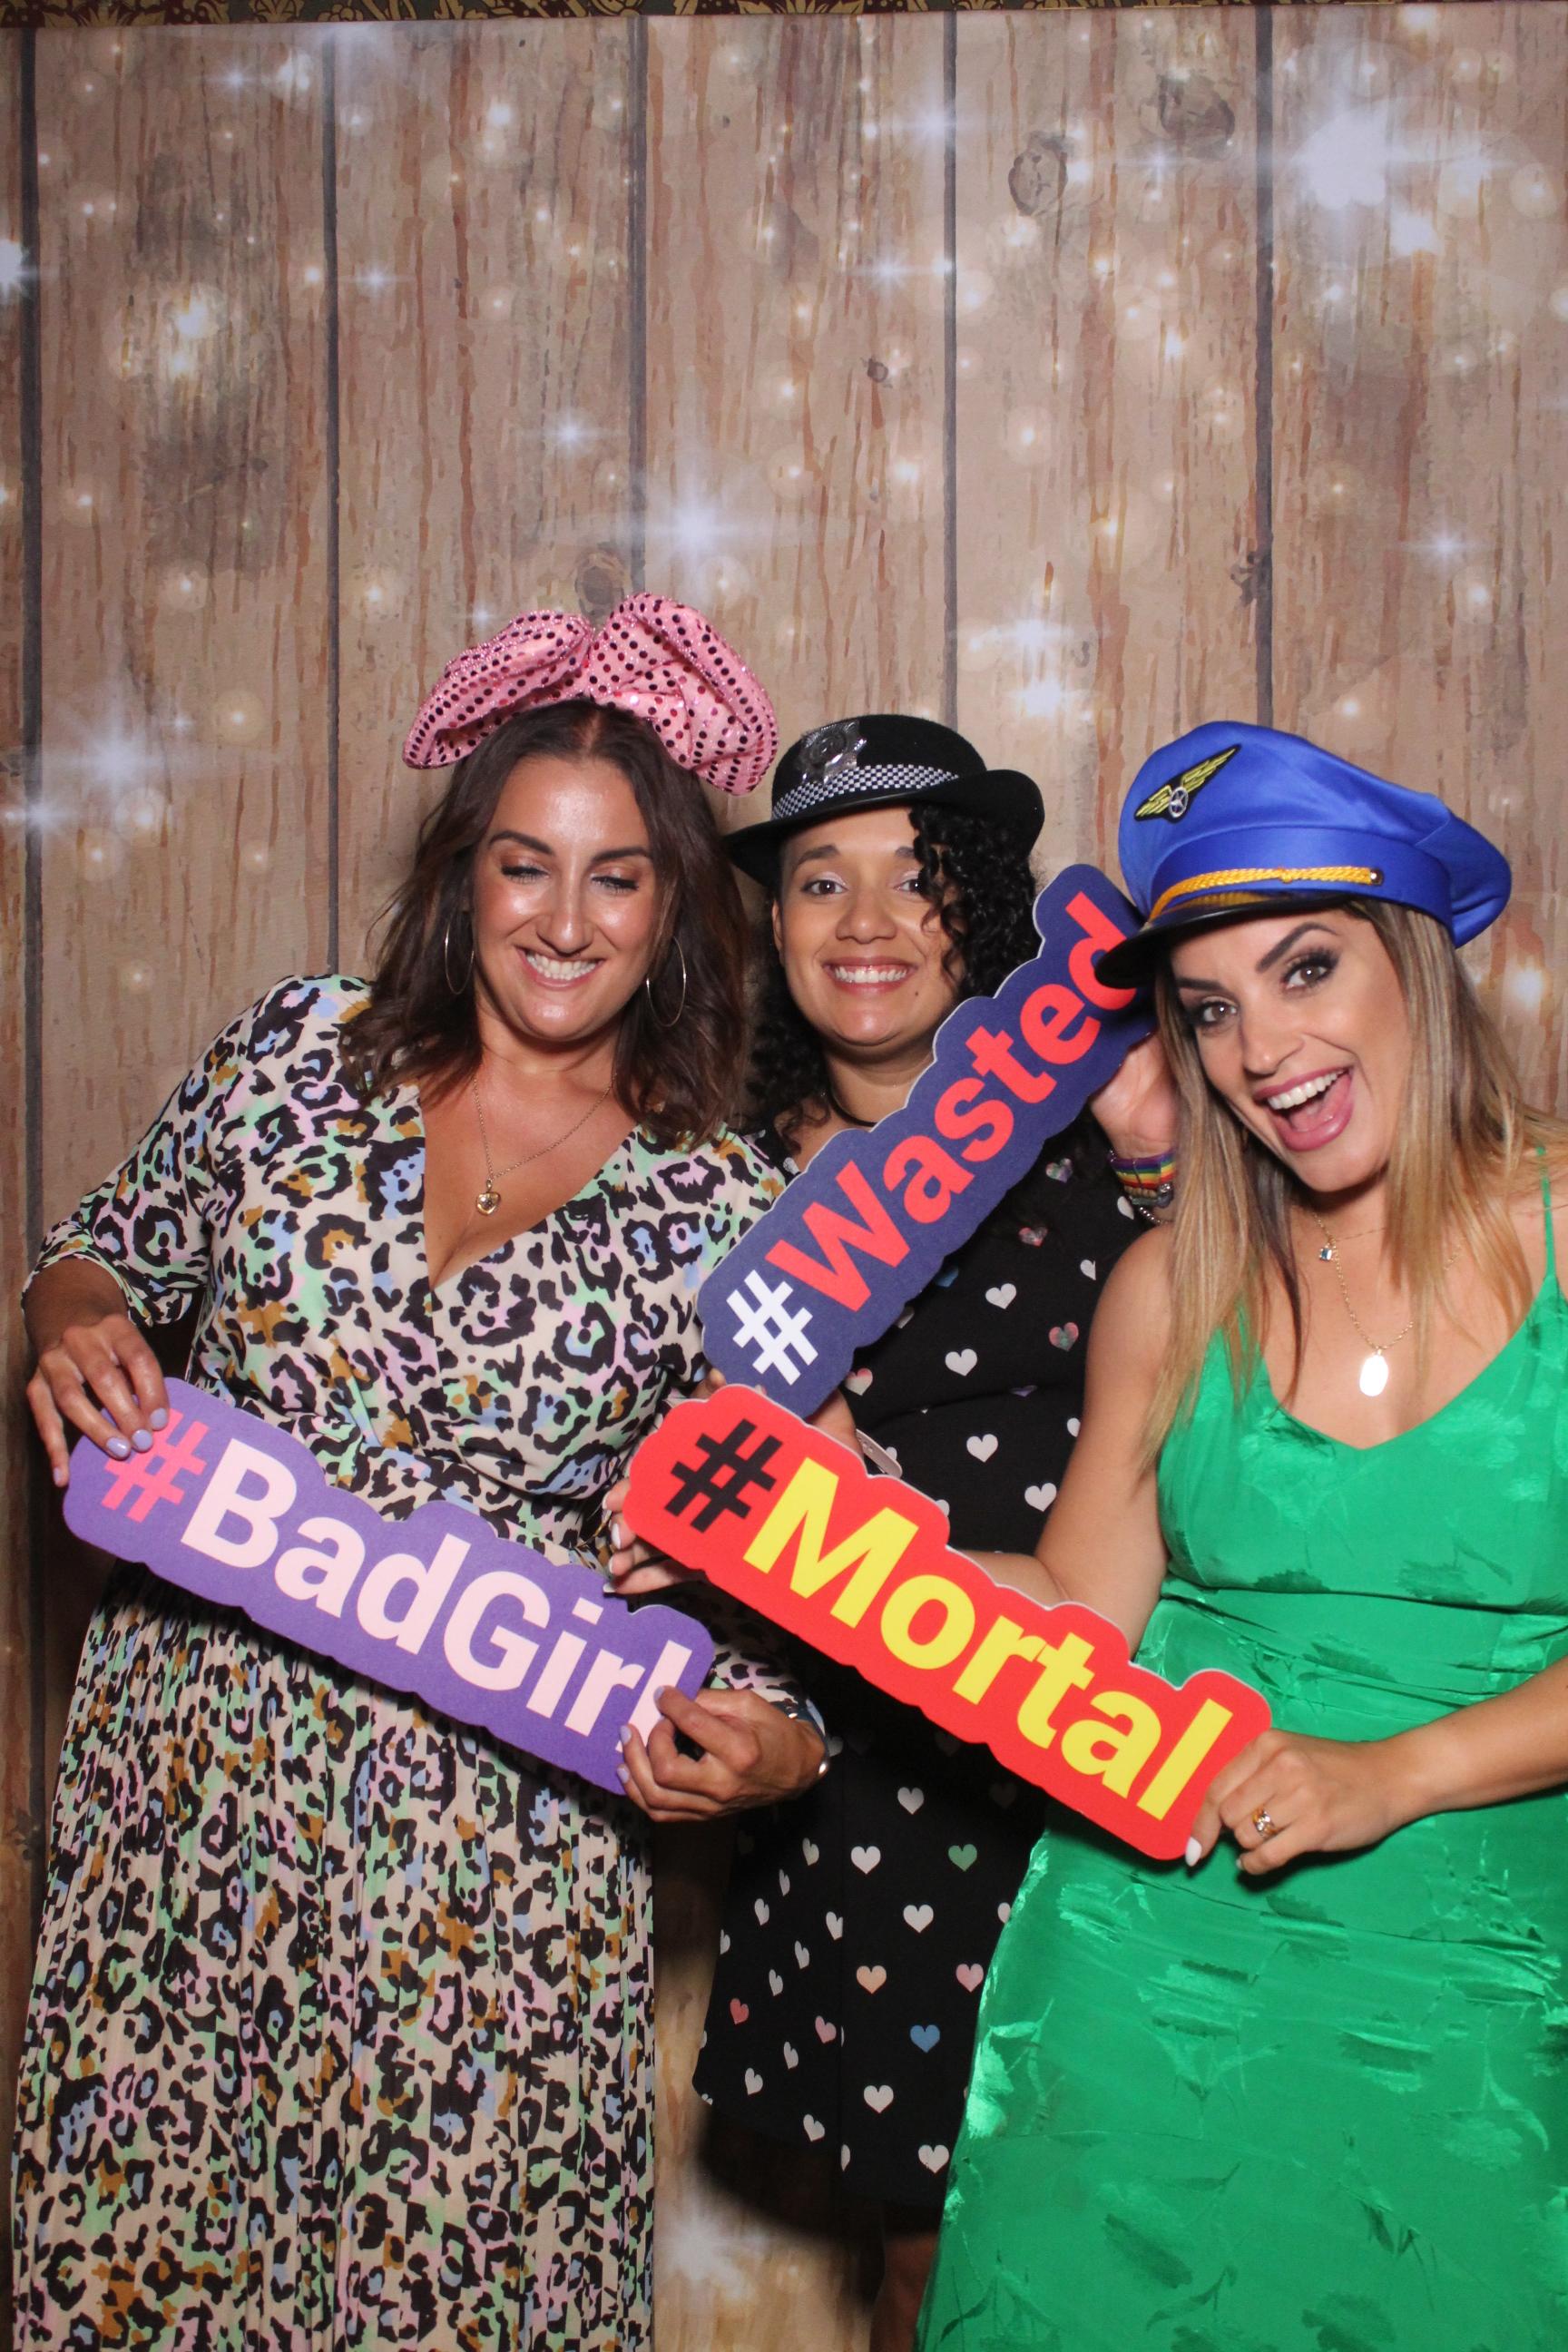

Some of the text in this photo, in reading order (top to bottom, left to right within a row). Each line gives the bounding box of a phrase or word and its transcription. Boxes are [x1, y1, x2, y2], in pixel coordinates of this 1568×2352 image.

[726, 891, 1138, 1386] #Wasted
[102, 1410, 692, 1754] #BadGirl
[664, 1418, 1233, 1821] #Mortal
